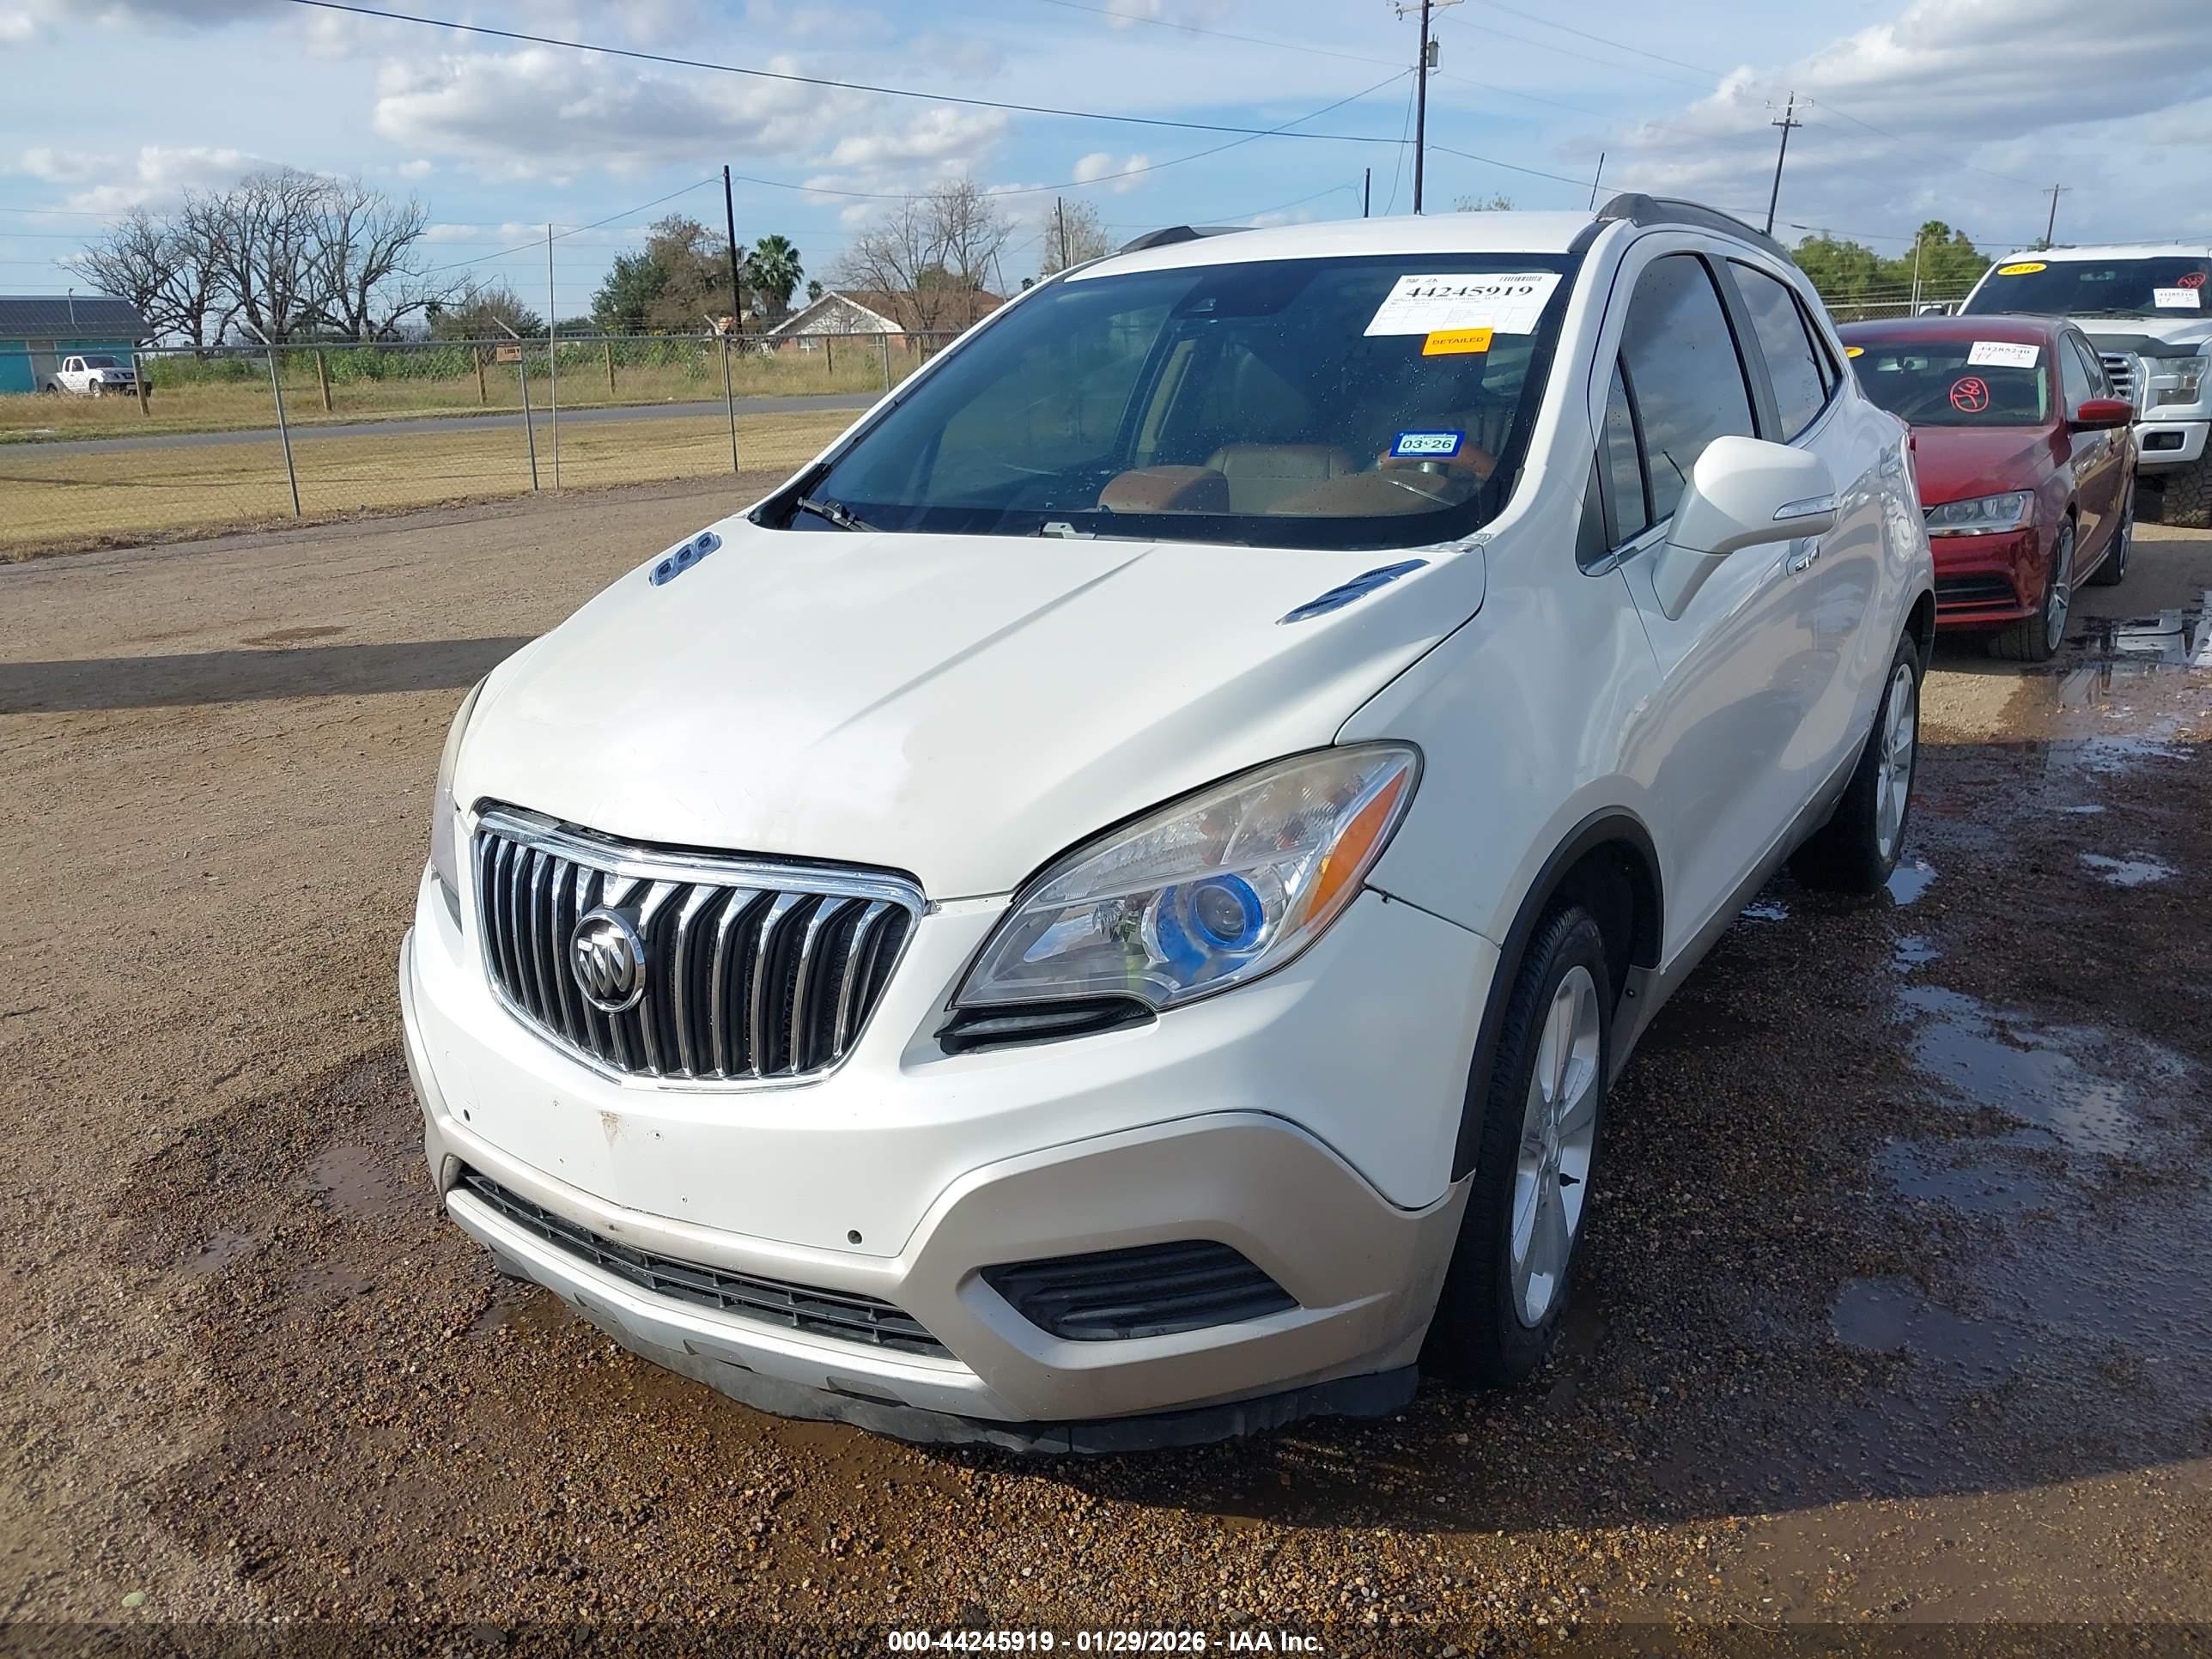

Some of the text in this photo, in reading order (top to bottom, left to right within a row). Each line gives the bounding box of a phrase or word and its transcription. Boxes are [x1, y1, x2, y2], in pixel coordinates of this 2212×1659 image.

[1405, 286, 1534, 298] 44245919
[1432, 337, 1484, 345] DETAILED
[1402, 440, 1453, 449] 03 26
